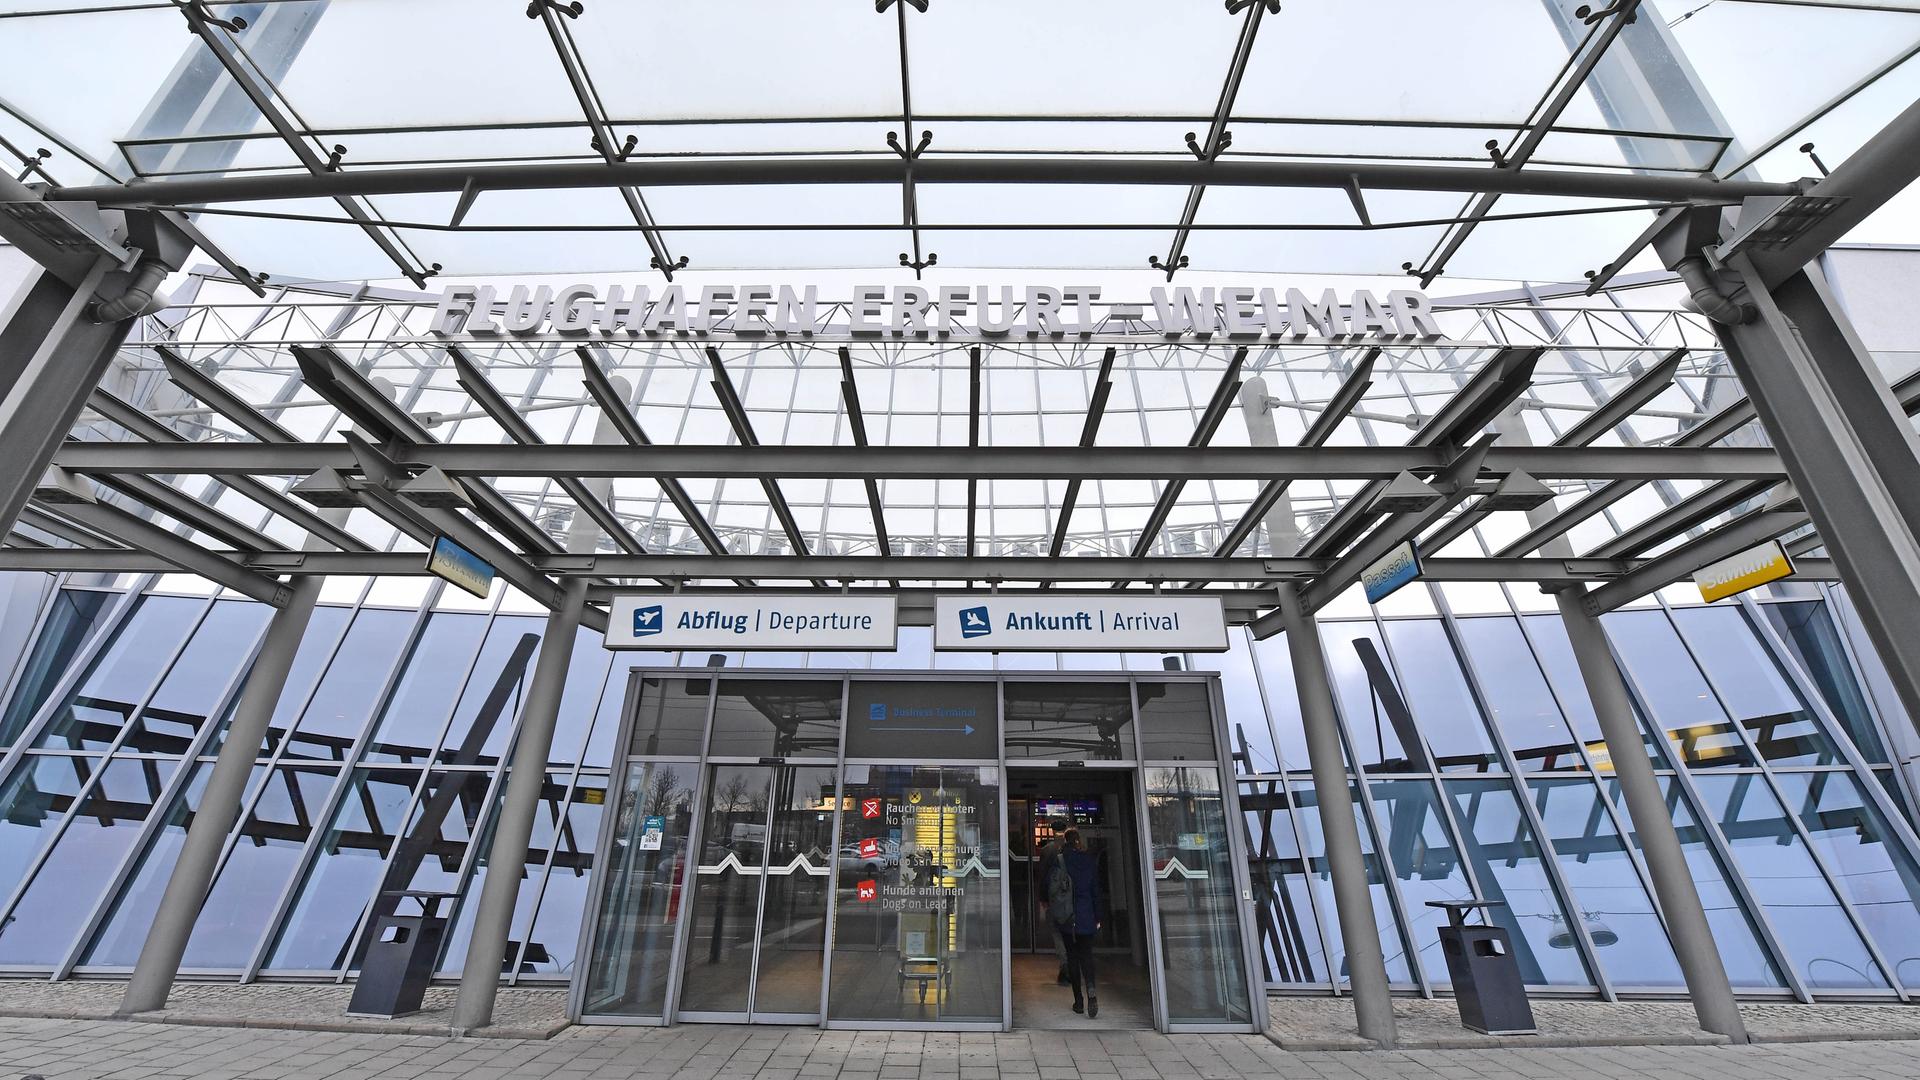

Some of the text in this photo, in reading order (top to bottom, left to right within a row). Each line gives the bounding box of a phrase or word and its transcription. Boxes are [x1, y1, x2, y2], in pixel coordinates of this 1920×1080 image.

[431, 284, 817, 337] FLUGHAFEN
[1364, 551, 1411, 592] Passat
[677, 611, 872, 634] Abflug Departure
[1006, 612, 1180, 631] Ankunft Arrival
[893, 706, 977, 717] Business Terminal
[885, 815, 898, 825] No
[883, 885, 964, 896] Hunde anleinen
[882, 899, 906, 911] Dogs
[925, 899, 947, 909] Lead
